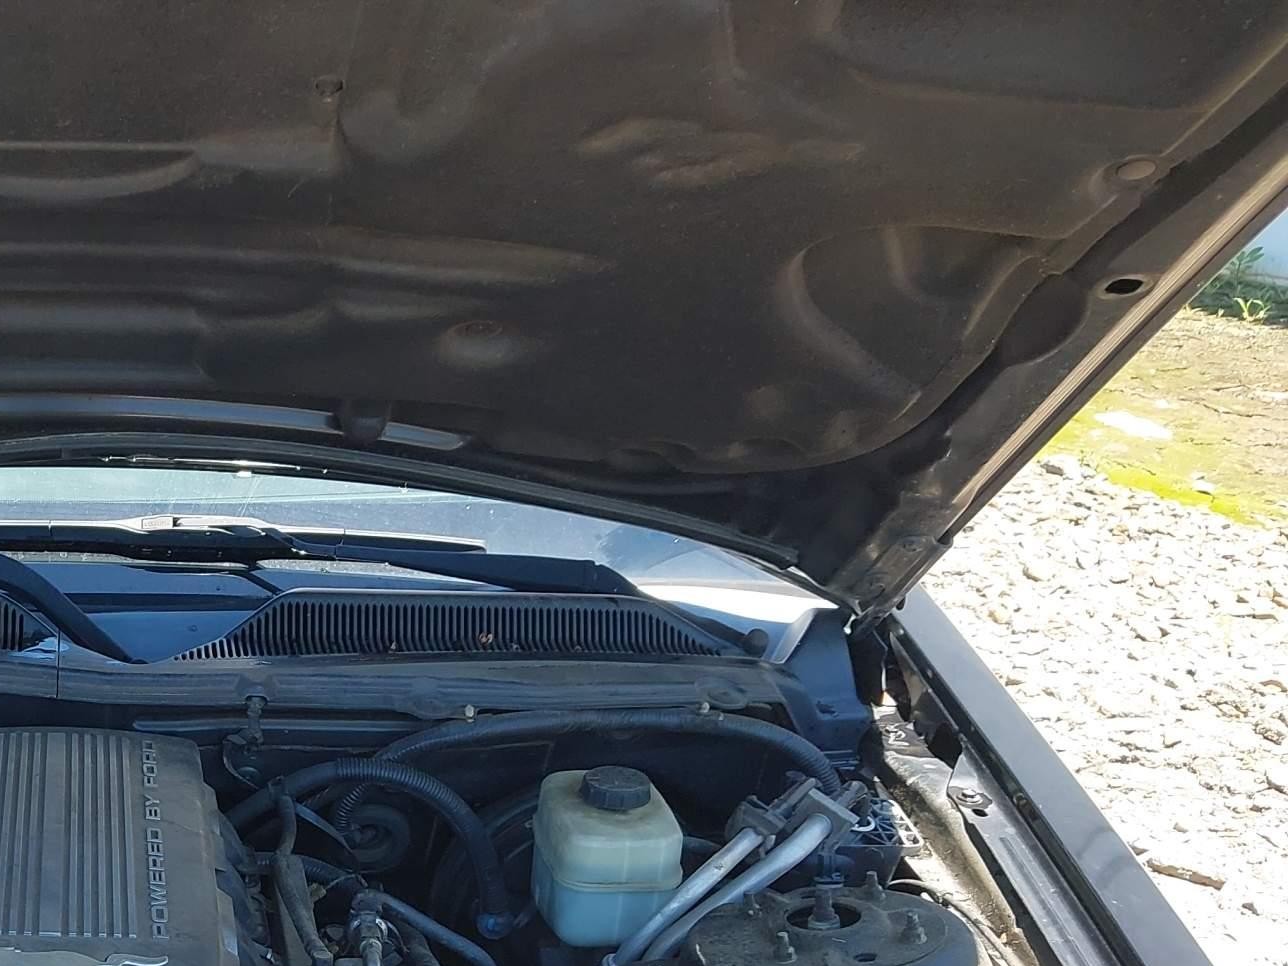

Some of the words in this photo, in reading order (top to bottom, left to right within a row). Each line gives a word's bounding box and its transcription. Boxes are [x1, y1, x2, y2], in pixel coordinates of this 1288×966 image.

[142, 740, 158, 788] FORD
[145, 794, 161, 821] BY
[146, 827, 169, 940] POWERED
